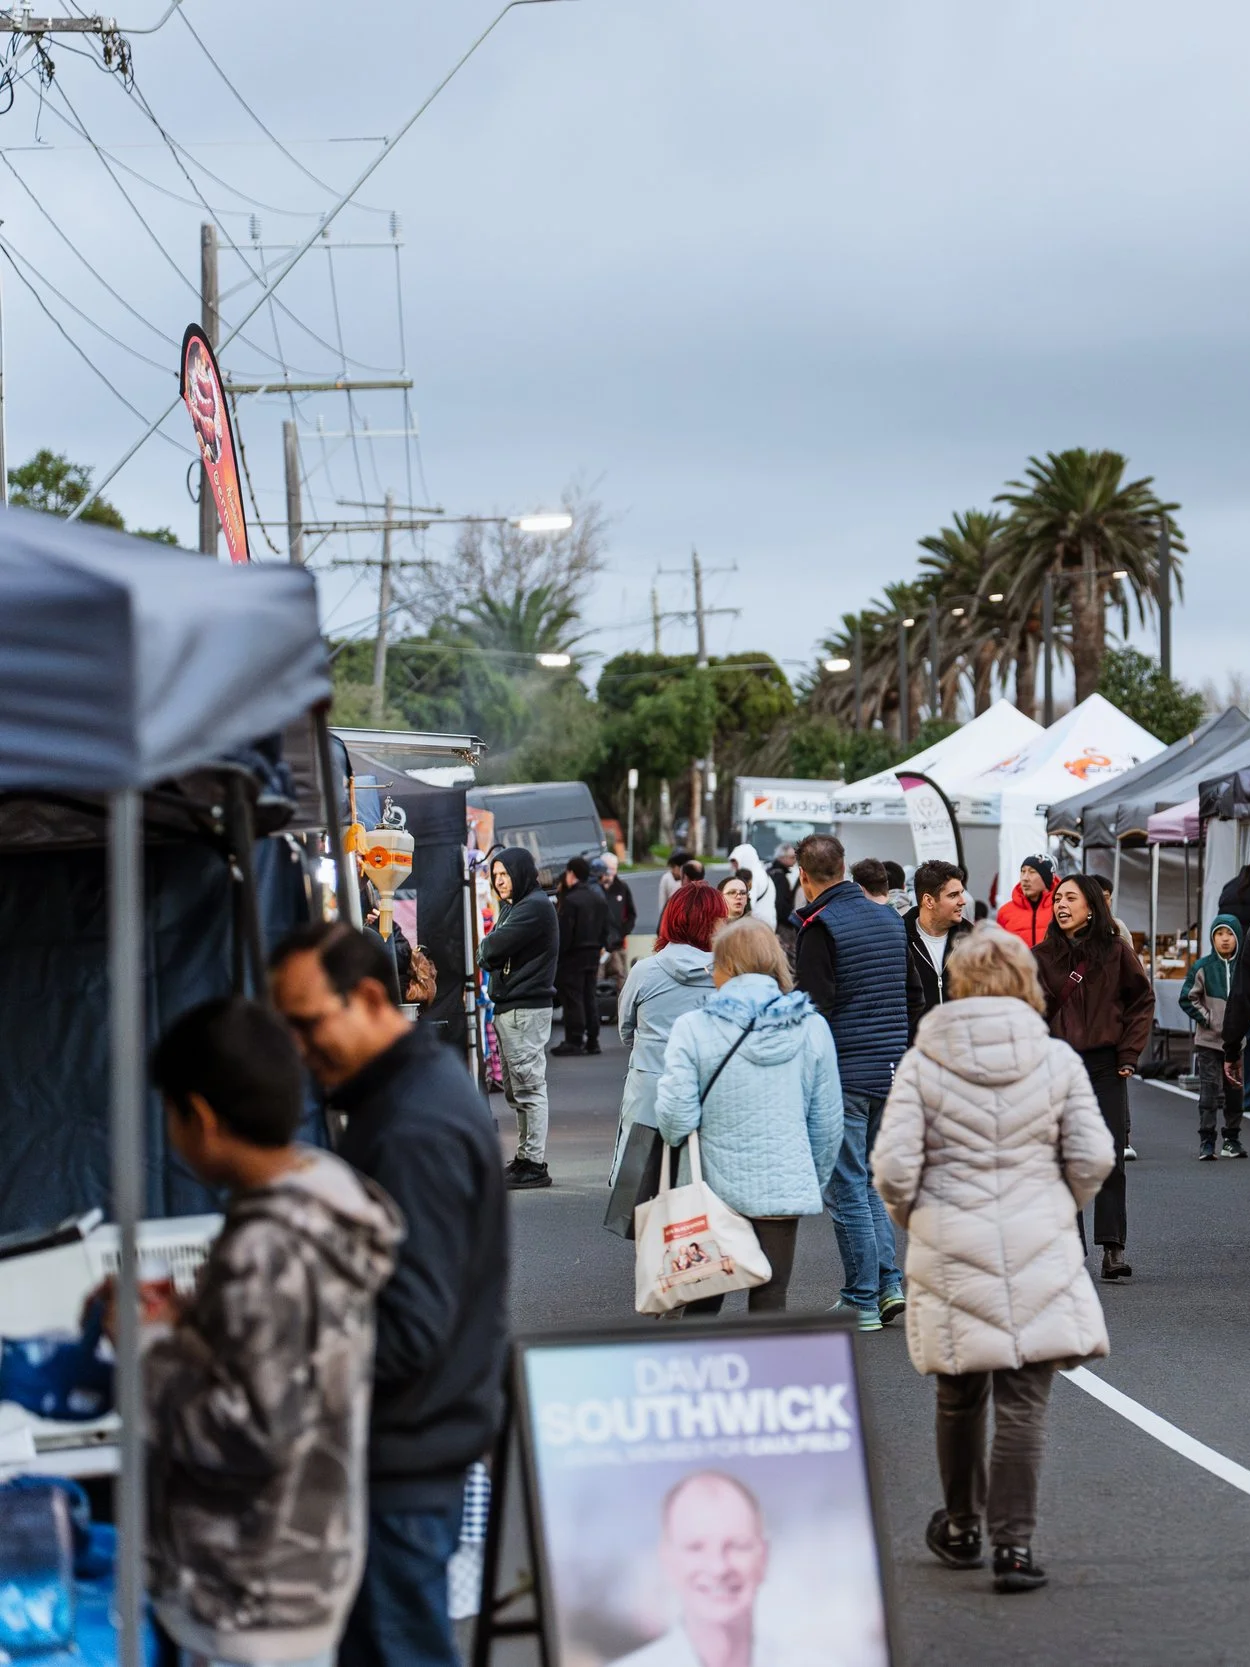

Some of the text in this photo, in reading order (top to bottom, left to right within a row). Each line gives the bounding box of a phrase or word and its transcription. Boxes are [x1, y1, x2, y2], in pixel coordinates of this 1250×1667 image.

[775, 797, 831, 816] Budge
[634, 1353, 750, 1394] DAVID
[539, 1384, 853, 1445] SOUTHWICK
